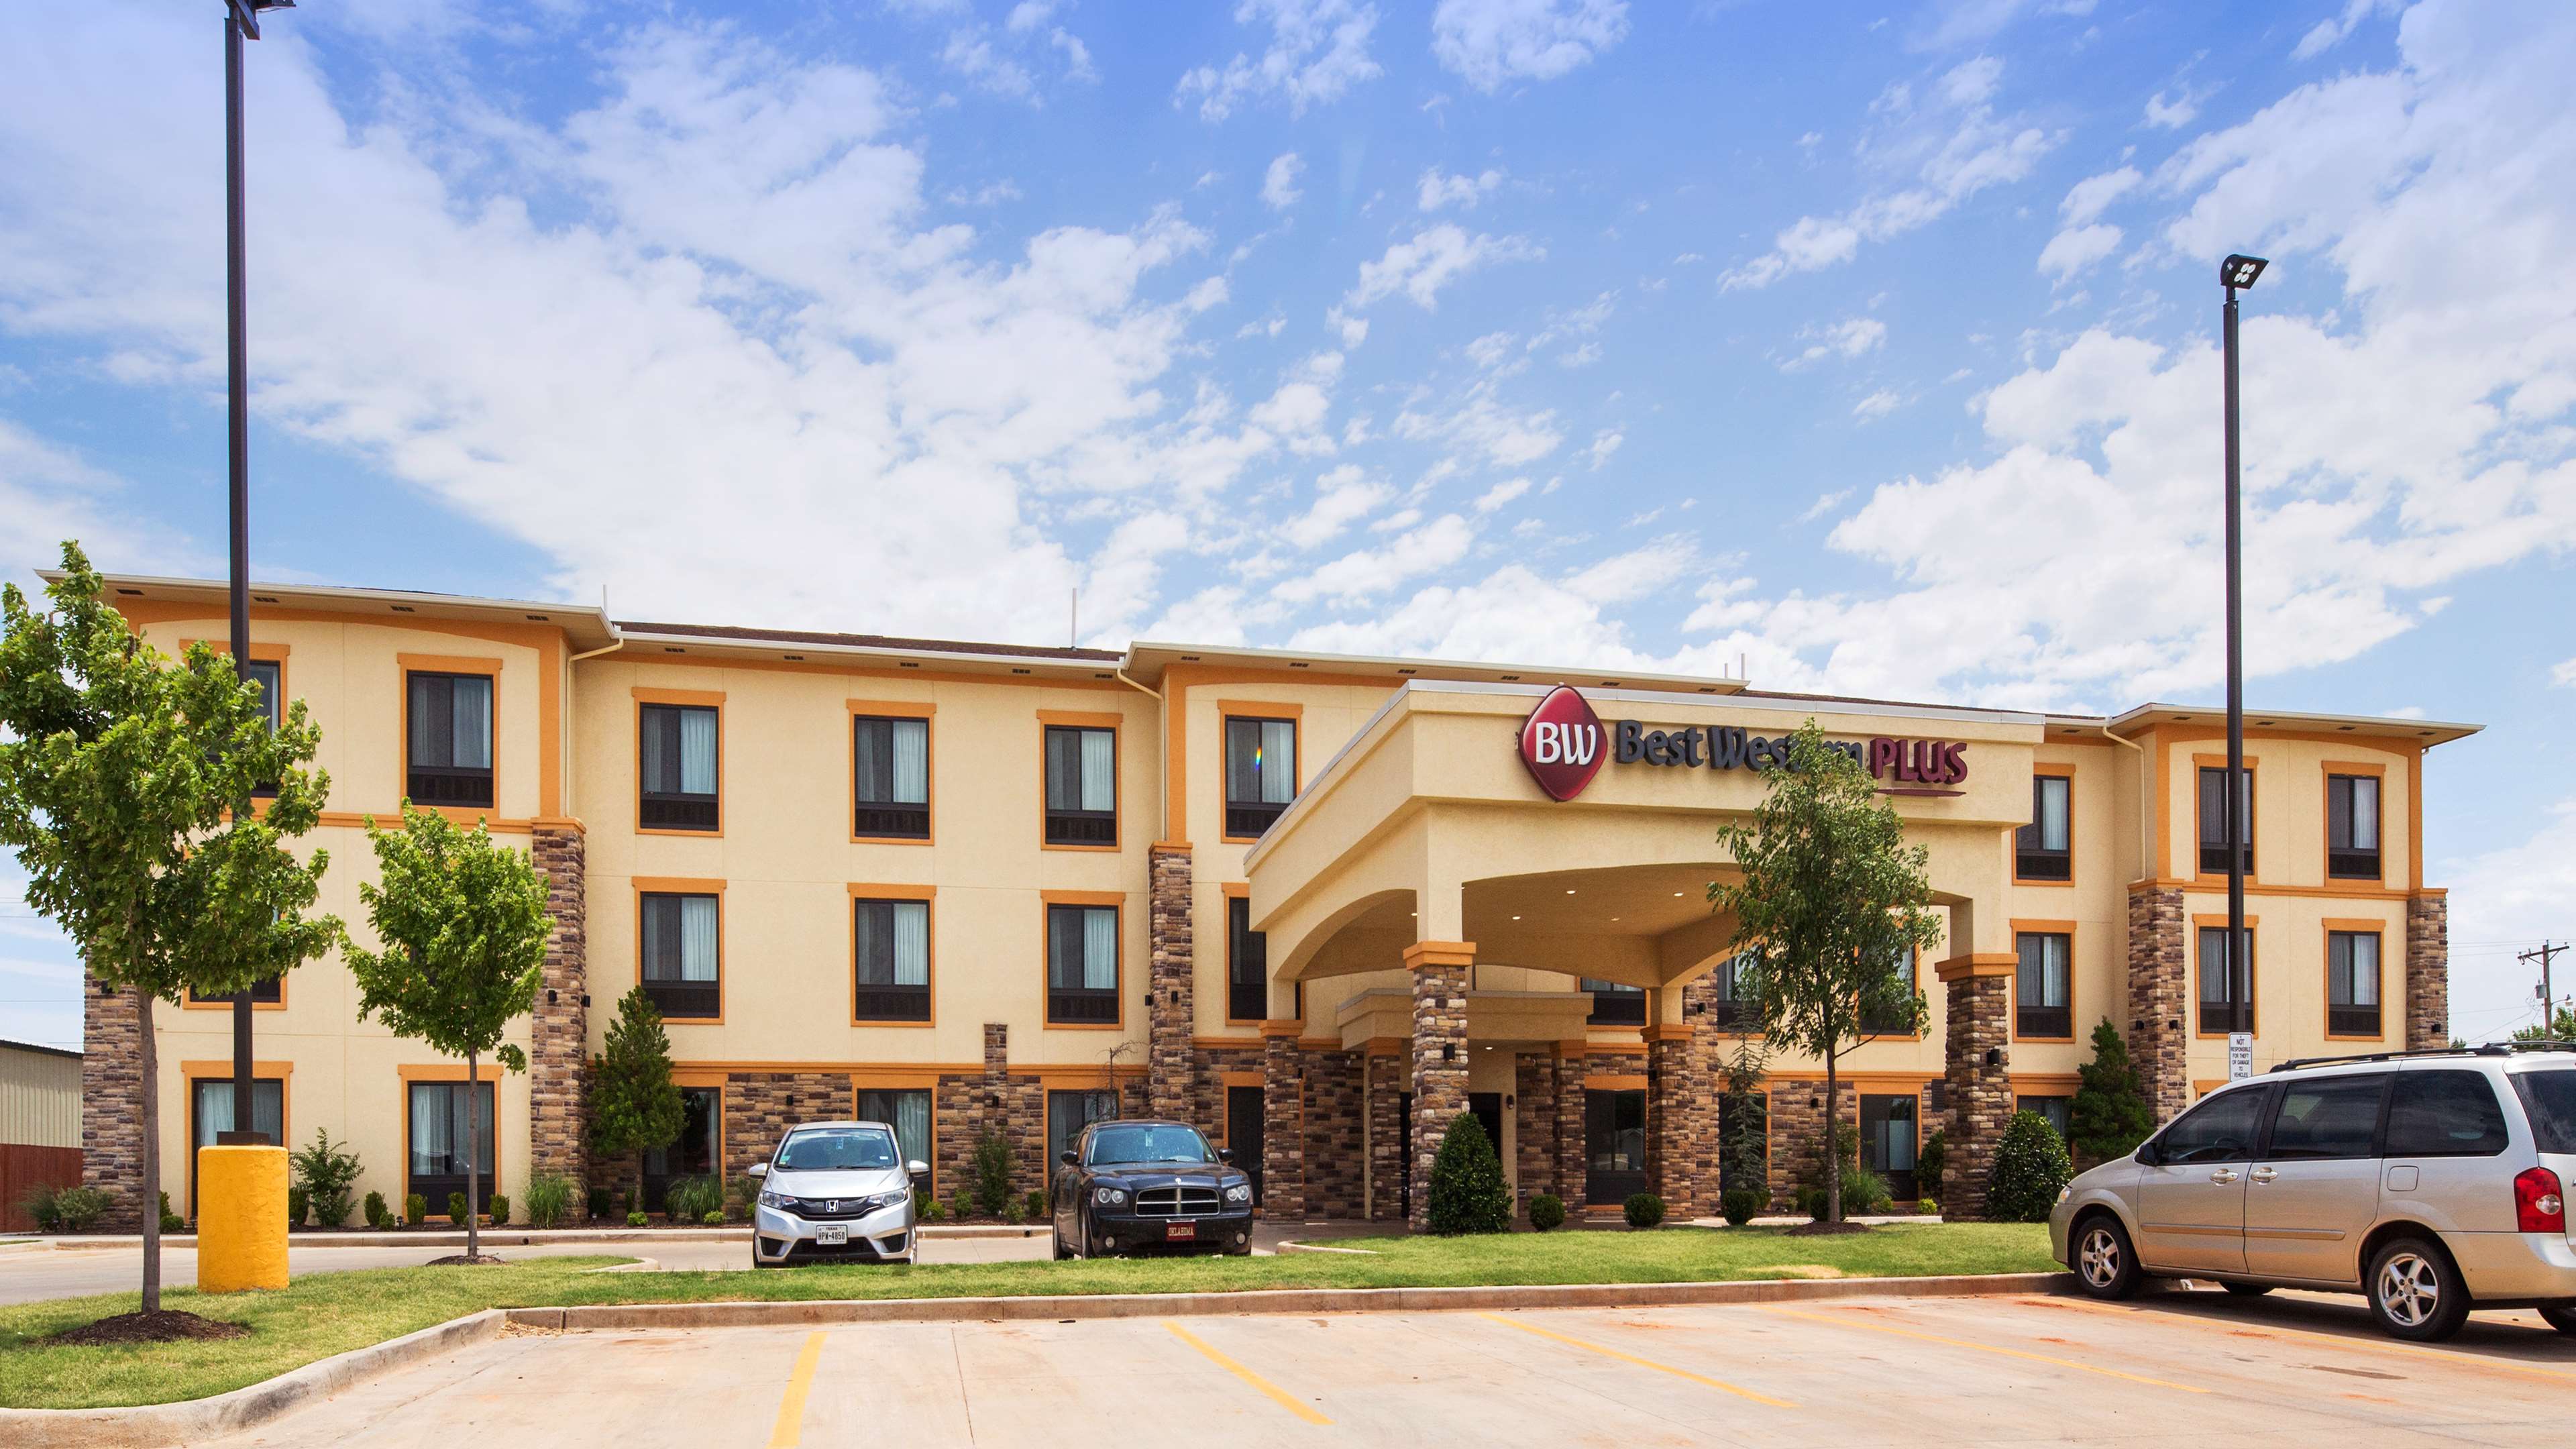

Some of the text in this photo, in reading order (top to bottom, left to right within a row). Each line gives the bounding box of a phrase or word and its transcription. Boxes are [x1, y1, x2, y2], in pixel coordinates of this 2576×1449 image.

[1536, 722, 1597, 765] BW
[1616, 720, 1968, 785] Best Westn PLUS
[1169, 1227, 1194, 1236] OKLAHOMA
